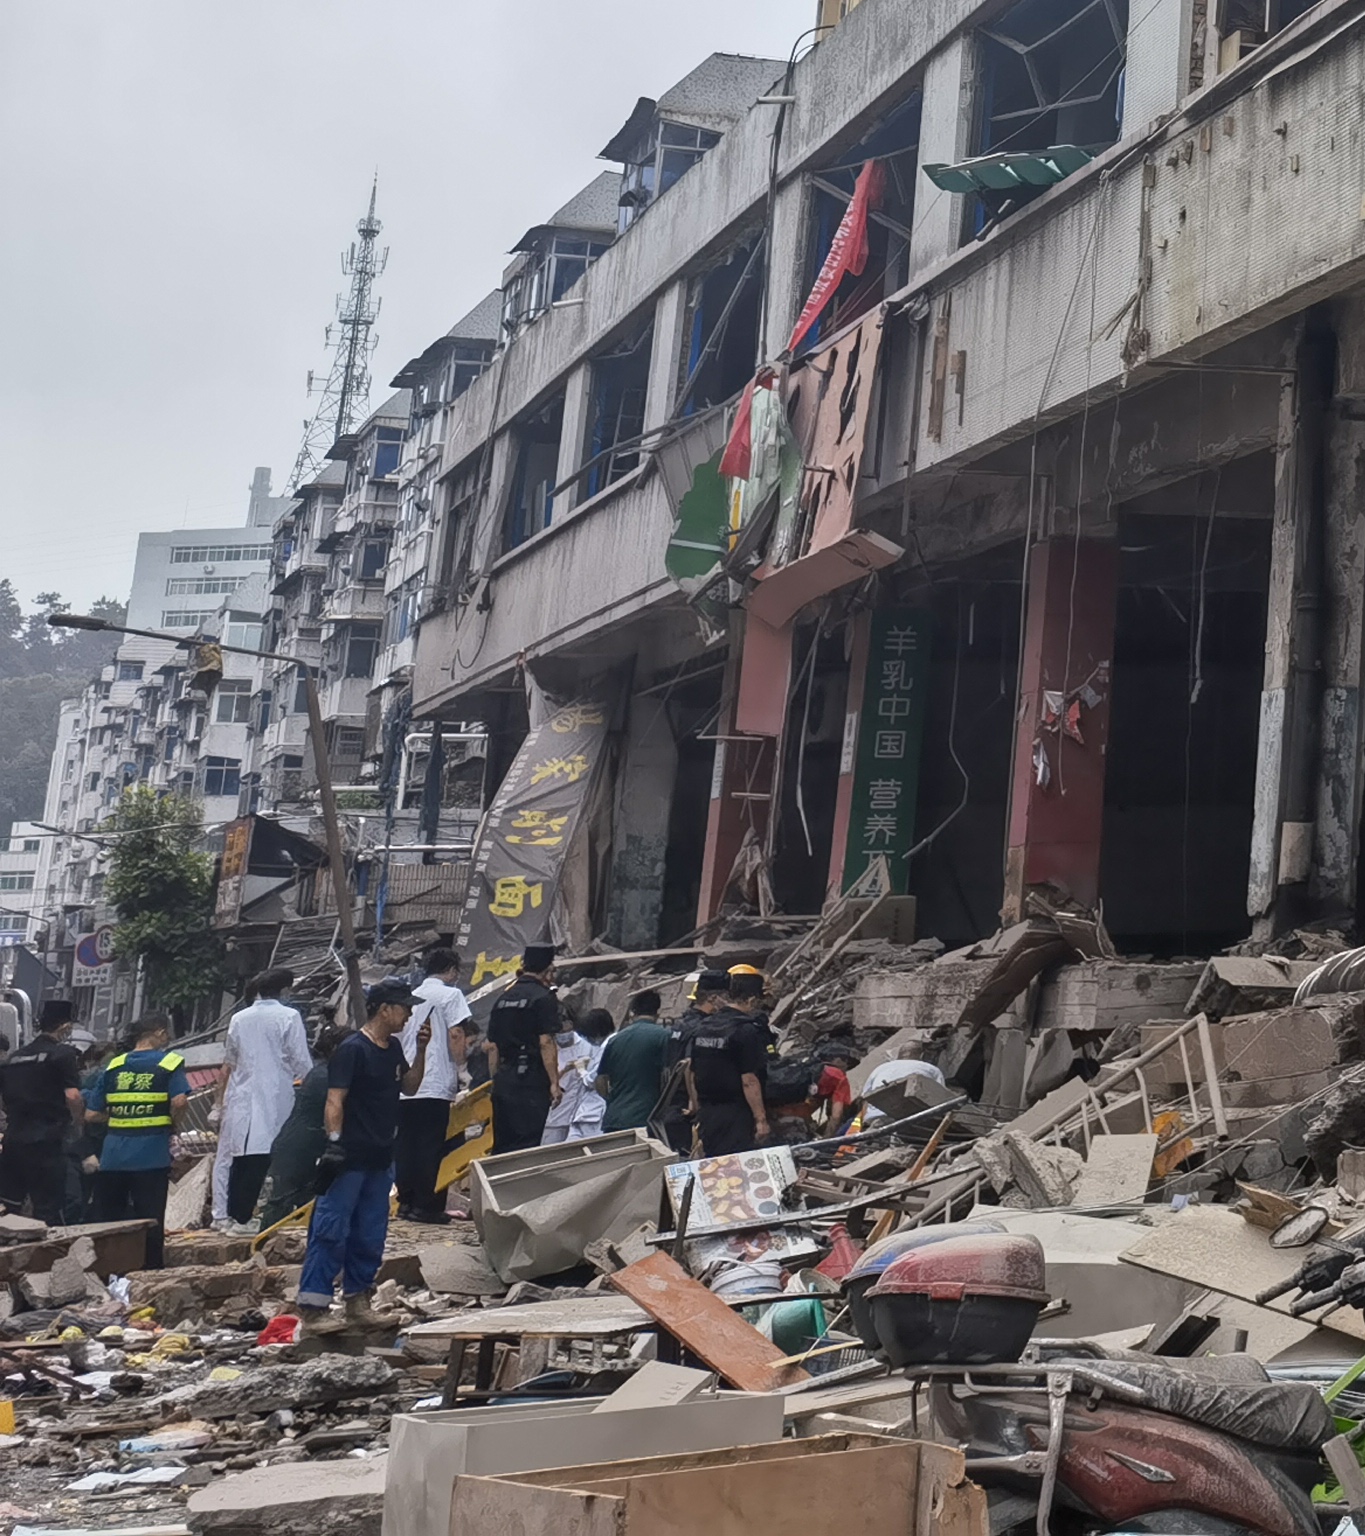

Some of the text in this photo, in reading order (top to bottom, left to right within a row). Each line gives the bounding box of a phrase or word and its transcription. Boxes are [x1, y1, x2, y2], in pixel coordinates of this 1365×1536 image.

[874, 625, 917, 759] 羊乳中国
[116, 1071, 155, 1090] 警察
